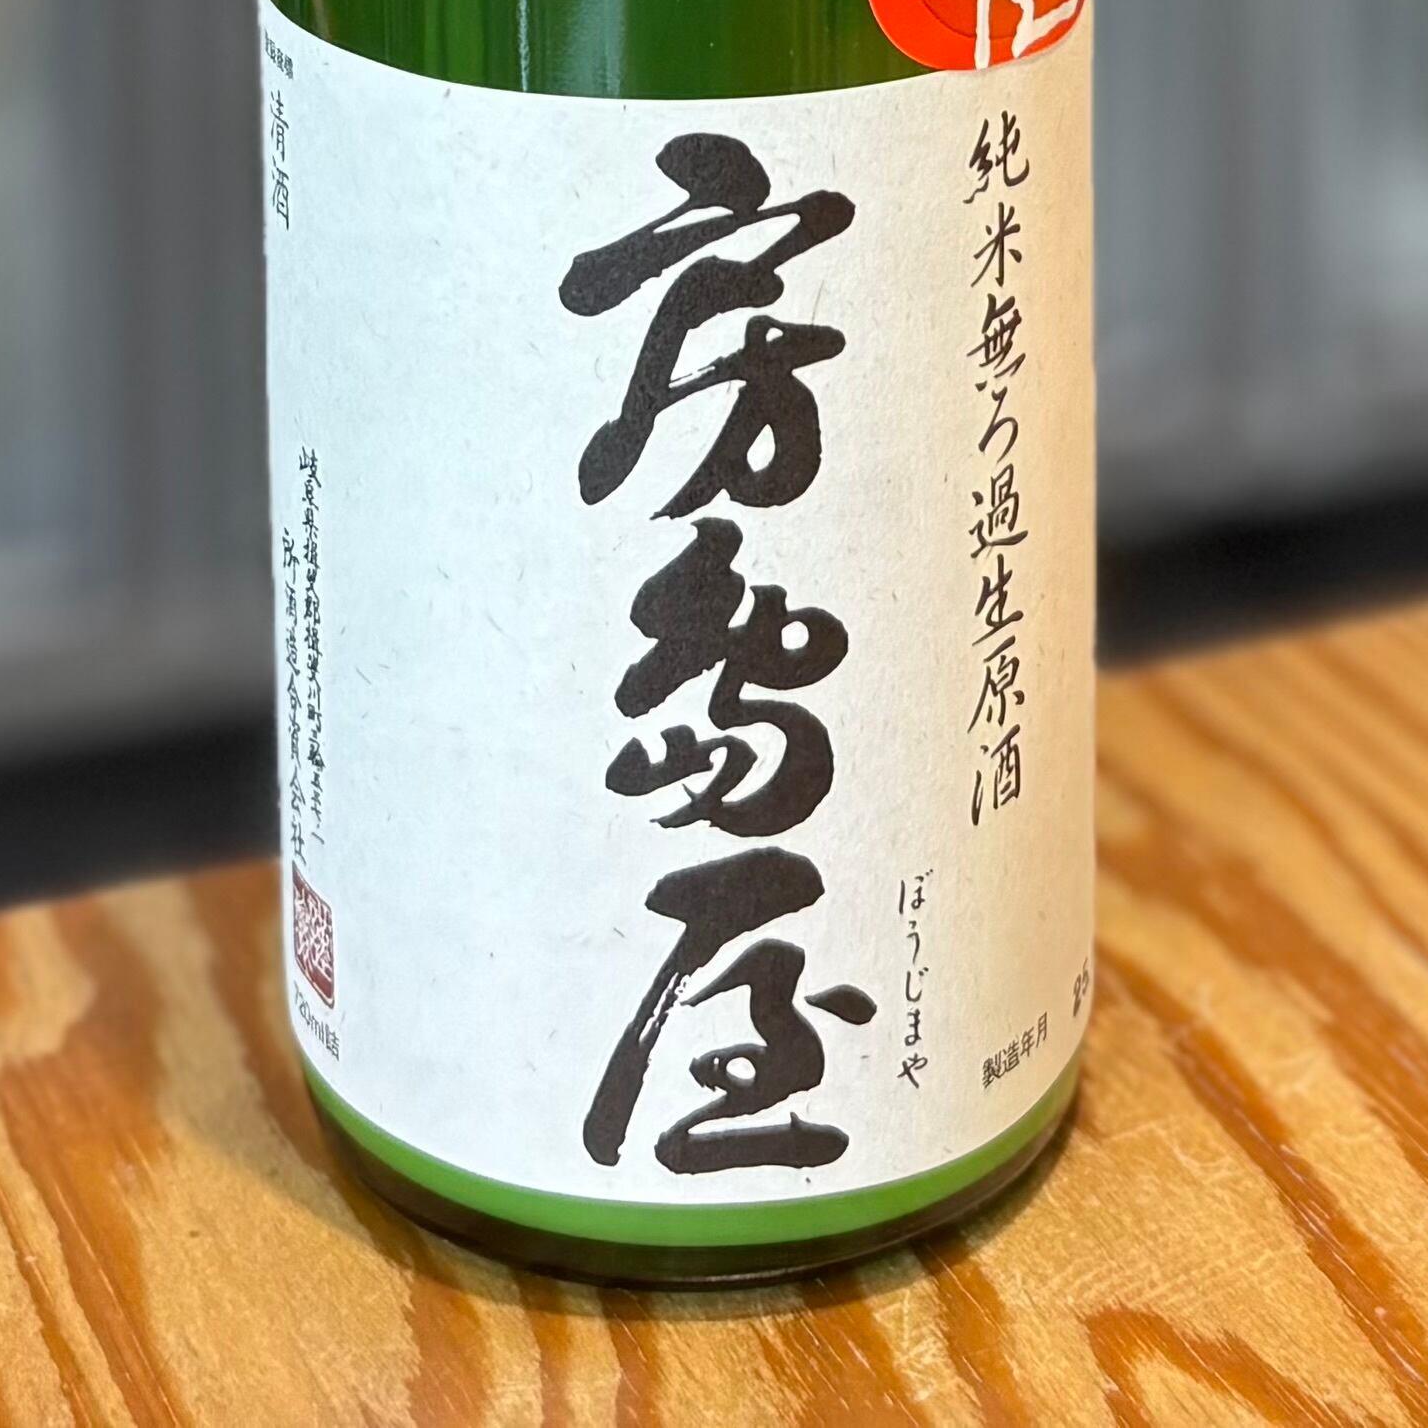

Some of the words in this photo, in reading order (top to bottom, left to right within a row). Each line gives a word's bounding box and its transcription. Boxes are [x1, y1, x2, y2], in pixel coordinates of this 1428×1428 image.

[963, 110, 1030, 826] 純米無ろ過生原酒
[896, 868, 934, 1089] ぼうじまや
[981, 1011, 1048, 1089] 製造年月
